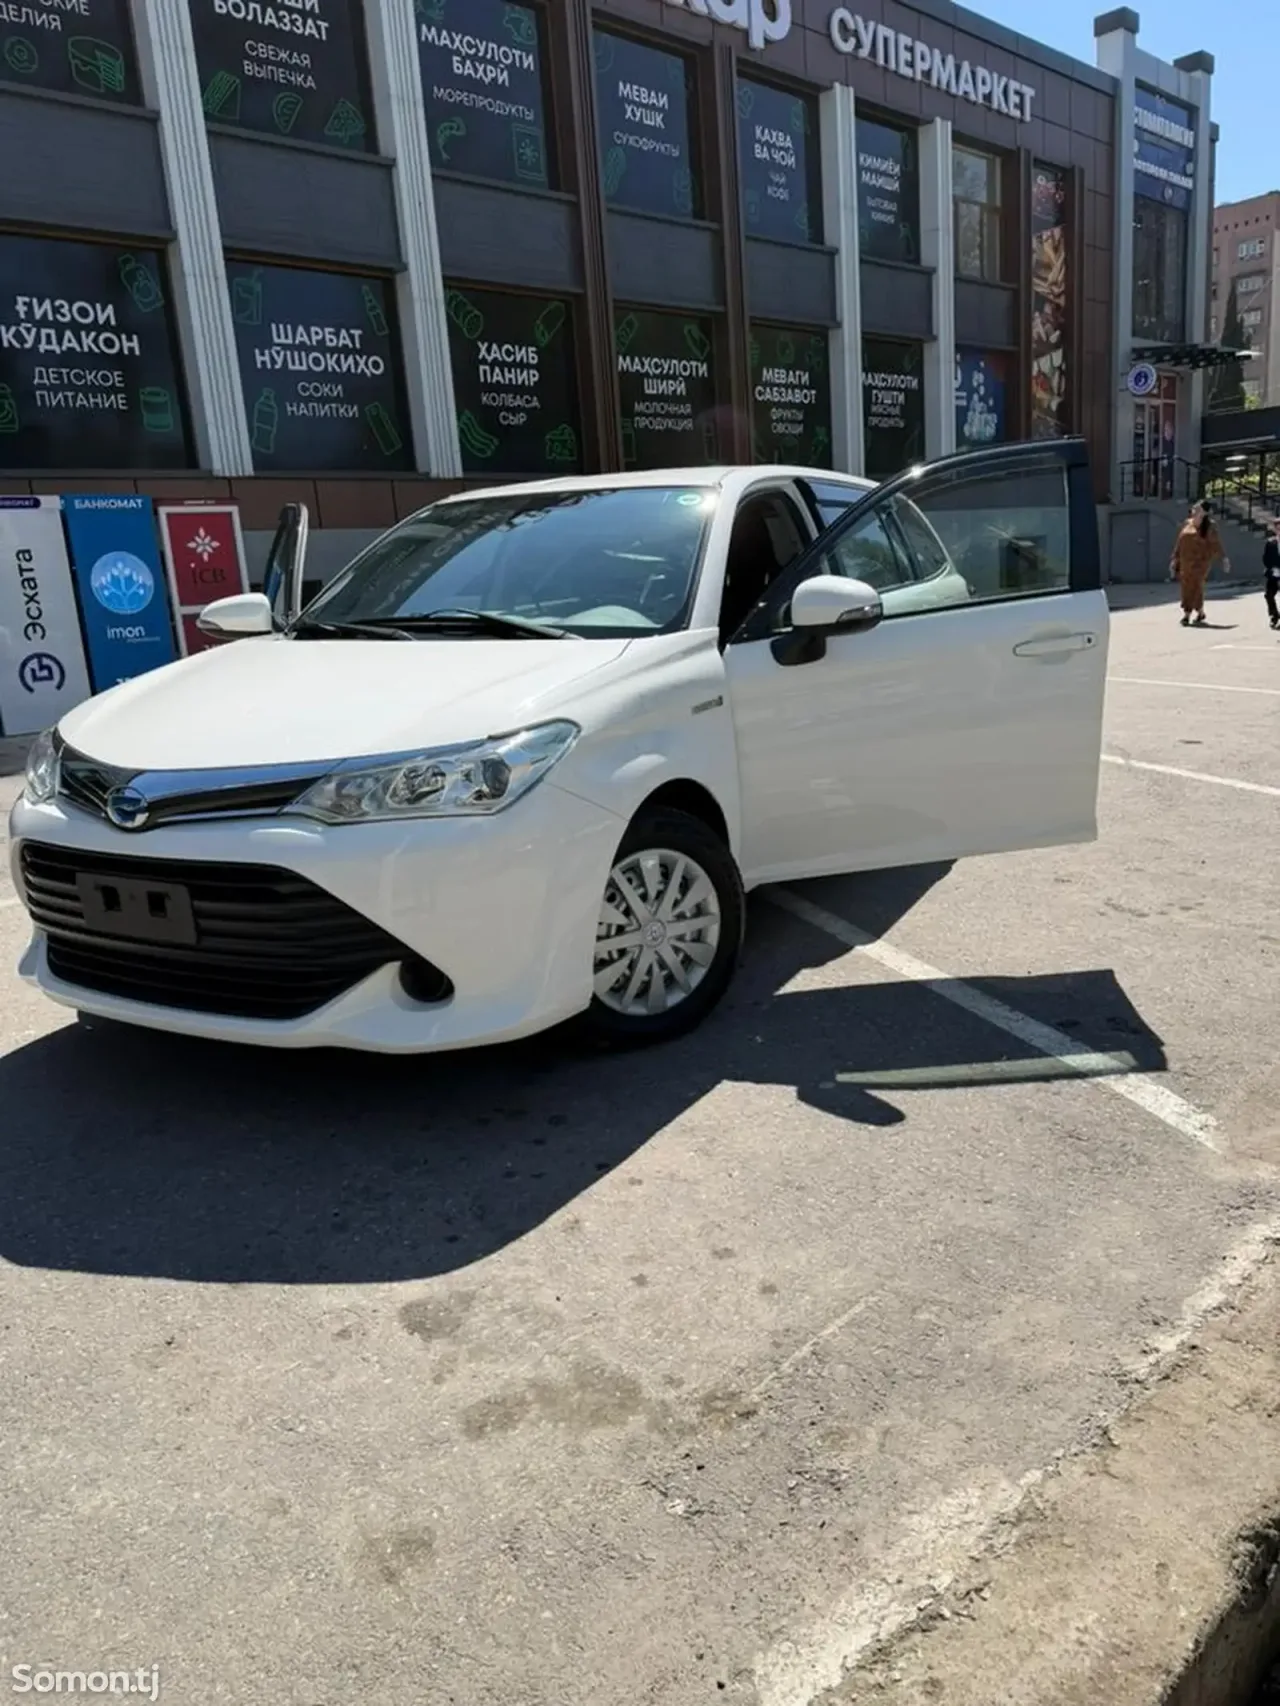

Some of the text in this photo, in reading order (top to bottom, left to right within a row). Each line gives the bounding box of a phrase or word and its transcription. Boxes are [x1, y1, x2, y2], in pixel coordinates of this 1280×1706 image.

[244, 40, 312, 68] СВЕЖАЯ
[421, 24, 534, 71] МАҲСУЛОТИ
[242, 60, 317, 90] ВЫПЕЧКА
[830, 7, 1036, 122] СУПЕРМАРКЕТ
[432, 86, 534, 121] МОРЕПРОДУКТЫ
[619, 81, 668, 110] МЕВАИ
[624, 103, 665, 129] ХУШК
[754, 143, 796, 169] ВА ЧОЙ
[15, 296, 116, 326] ҒИЗОИ
[0, 323, 140, 356] КӮДАКОН
[271, 322, 363, 349] ШАРБАТ
[33, 366, 125, 387] ДЕТСКОЕ
[479, 365, 540, 387] ПАНИР
[618, 355, 708, 378] МАҲСУЛОТИ
[762, 367, 809, 386] МЕВАГИ
[35, 390, 128, 410] ПИТАНИЕ
[297, 382, 344, 398] СОКИ
[481, 392, 541, 409] КОЛБАСА
[755, 386, 817, 404] САБЗАВОТ
[285, 402, 359, 418] НАПИТКИ
[499, 411, 527, 426] СЫР
[634, 401, 692, 415] МОЛОЧНАЯ
[634, 416, 693, 431] ПРОДУКЦИЯ
[74, 499, 143, 510] БАНКОМАТ
